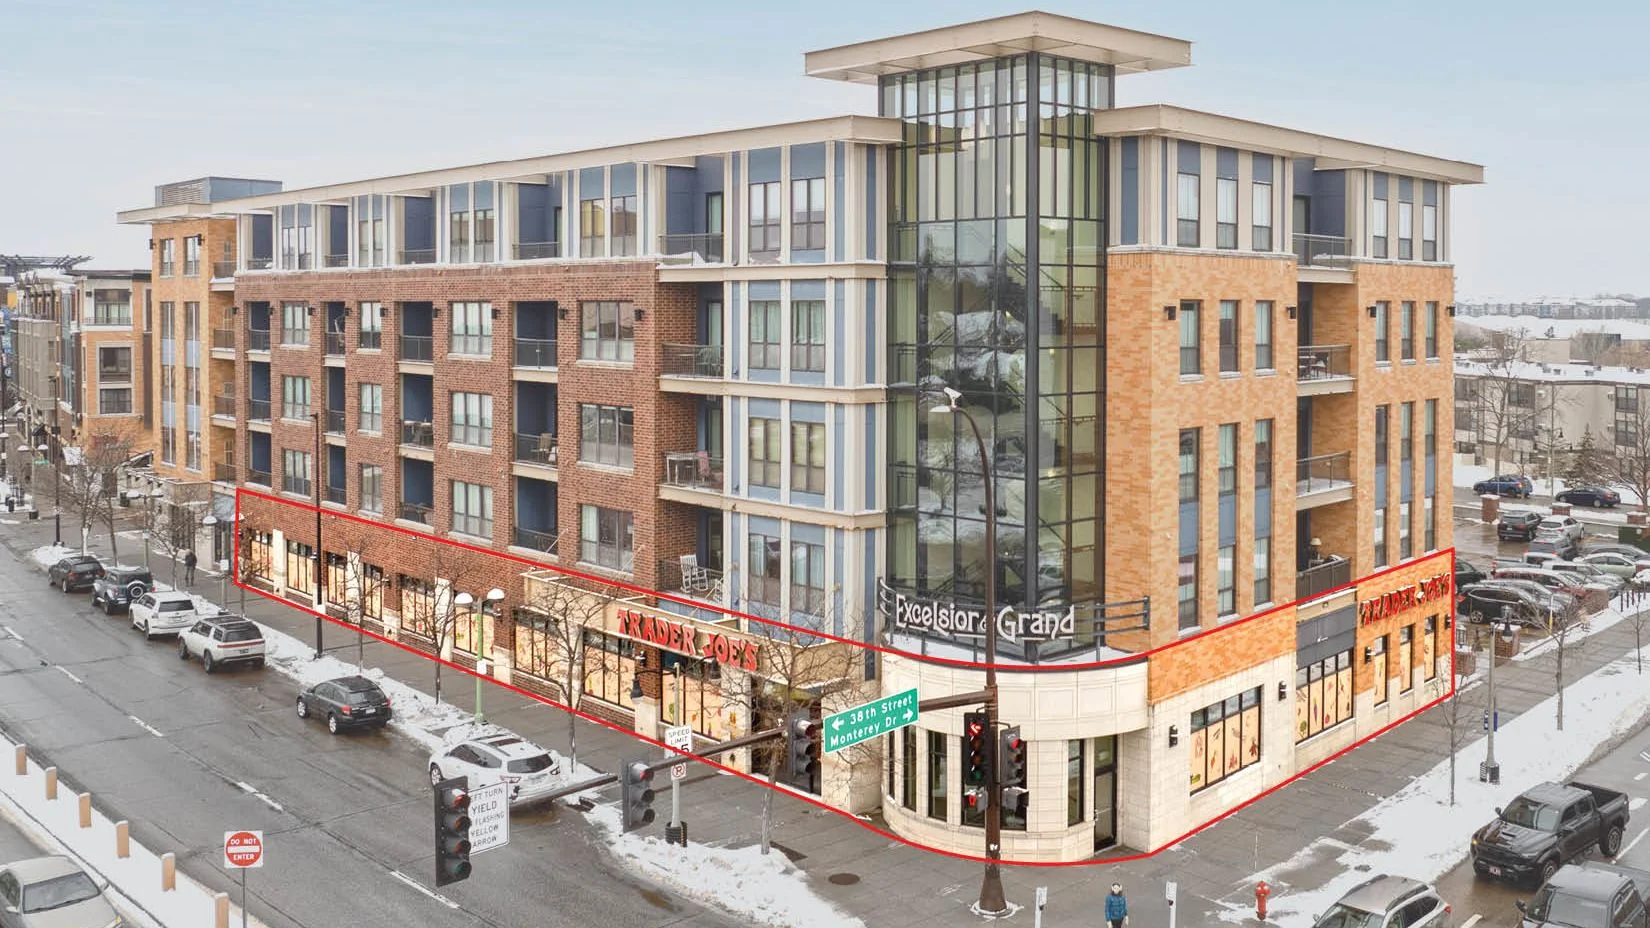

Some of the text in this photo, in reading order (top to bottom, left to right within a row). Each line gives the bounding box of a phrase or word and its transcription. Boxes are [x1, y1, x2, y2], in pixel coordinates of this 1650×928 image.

[1360, 585, 1416, 627] TRADER
[997, 605, 1075, 643] Grand
[616, 607, 760, 671] TRADER JOE'S
[850, 694, 912, 725] 38th Street
[668, 728, 690, 738] SPEED
[830, 716, 897, 748] Monterey Dr
[671, 736, 688, 745] LIMIT
[485, 787, 503, 798] TURN
[471, 800, 497, 814] YIELD
[470, 823, 499, 837] YELLOW
[472, 835, 497, 848] ARROW
